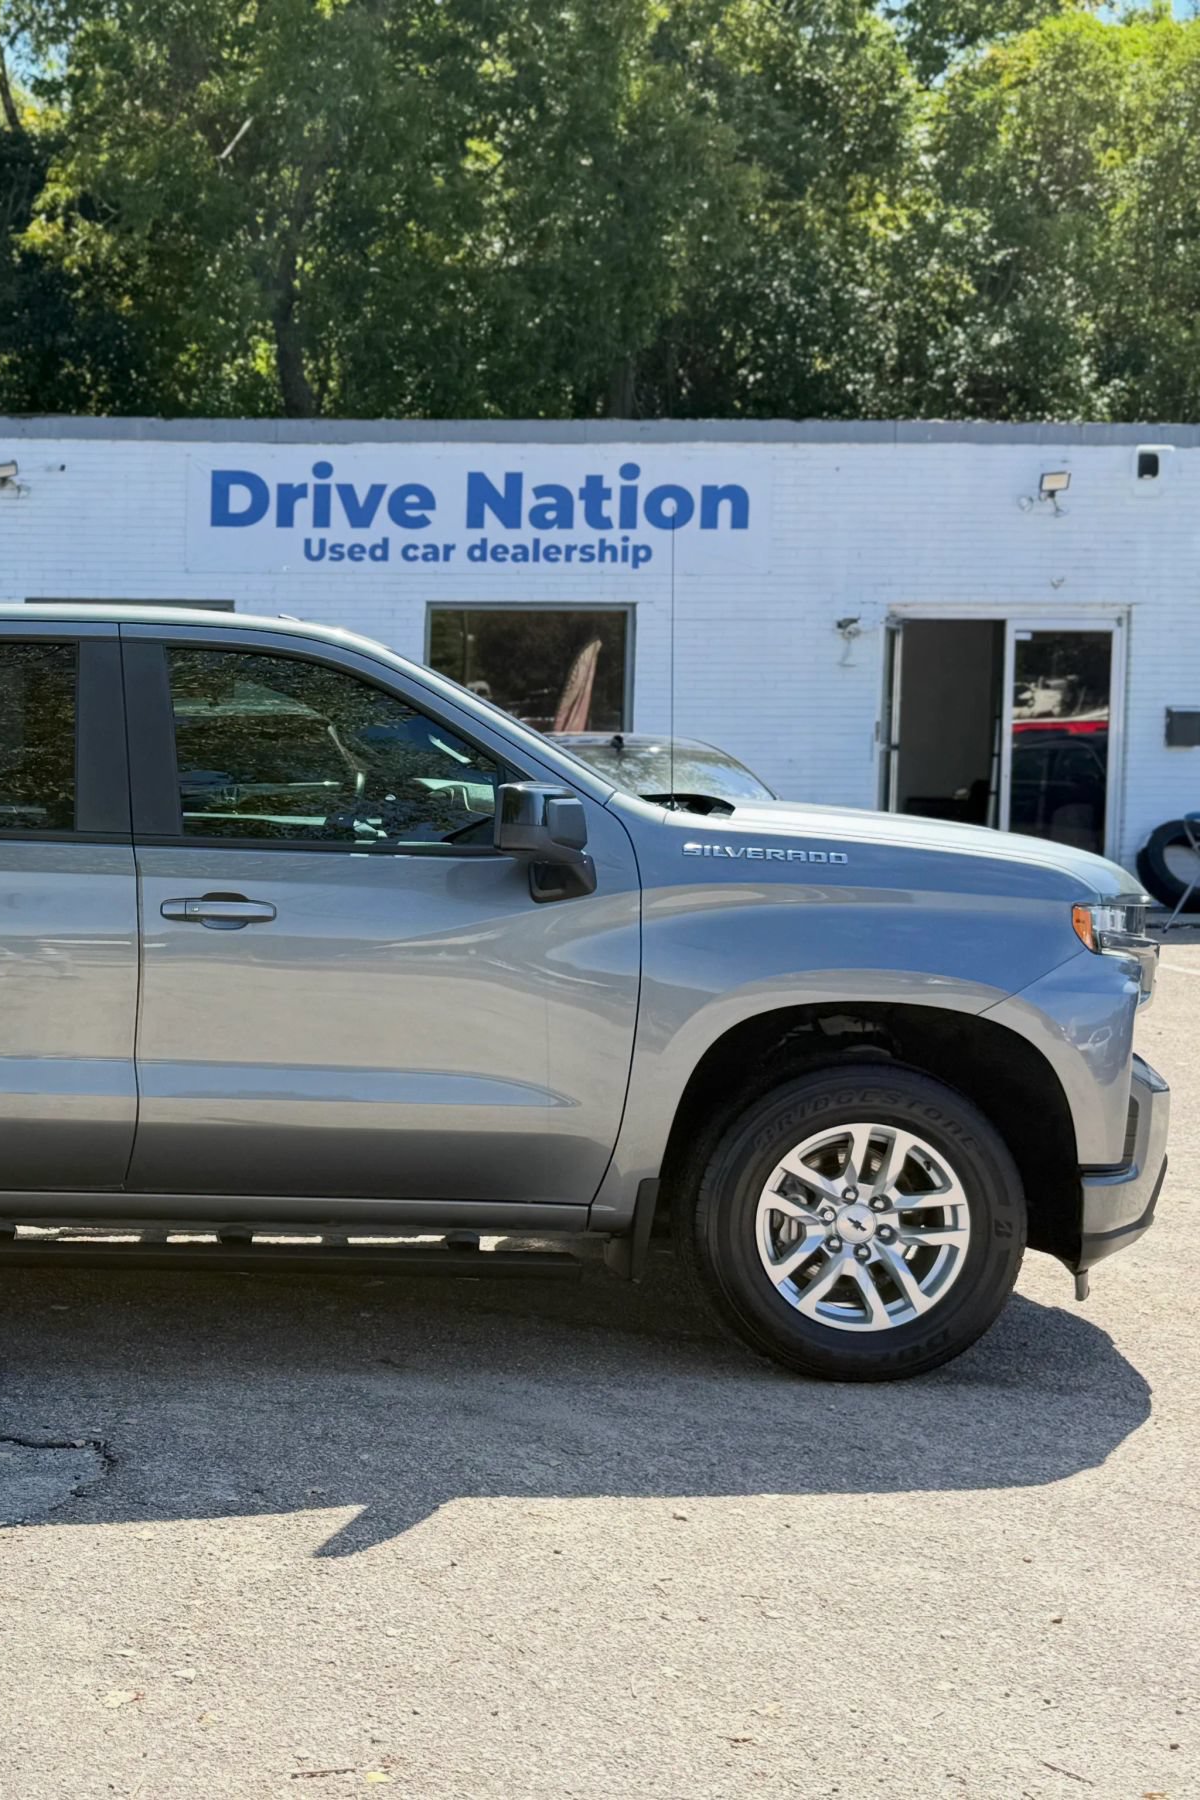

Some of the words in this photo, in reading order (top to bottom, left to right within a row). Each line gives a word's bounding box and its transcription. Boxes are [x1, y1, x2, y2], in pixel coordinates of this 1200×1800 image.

[210, 460, 437, 530] Drive
[465, 462, 750, 532] Nation
[303, 536, 390, 563] Used
[400, 543, 457, 563] car
[466, 535, 653, 570] dealership
[682, 842, 848, 865] SILVERADO
[753, 1087, 979, 1152] BRIDGESTONE
